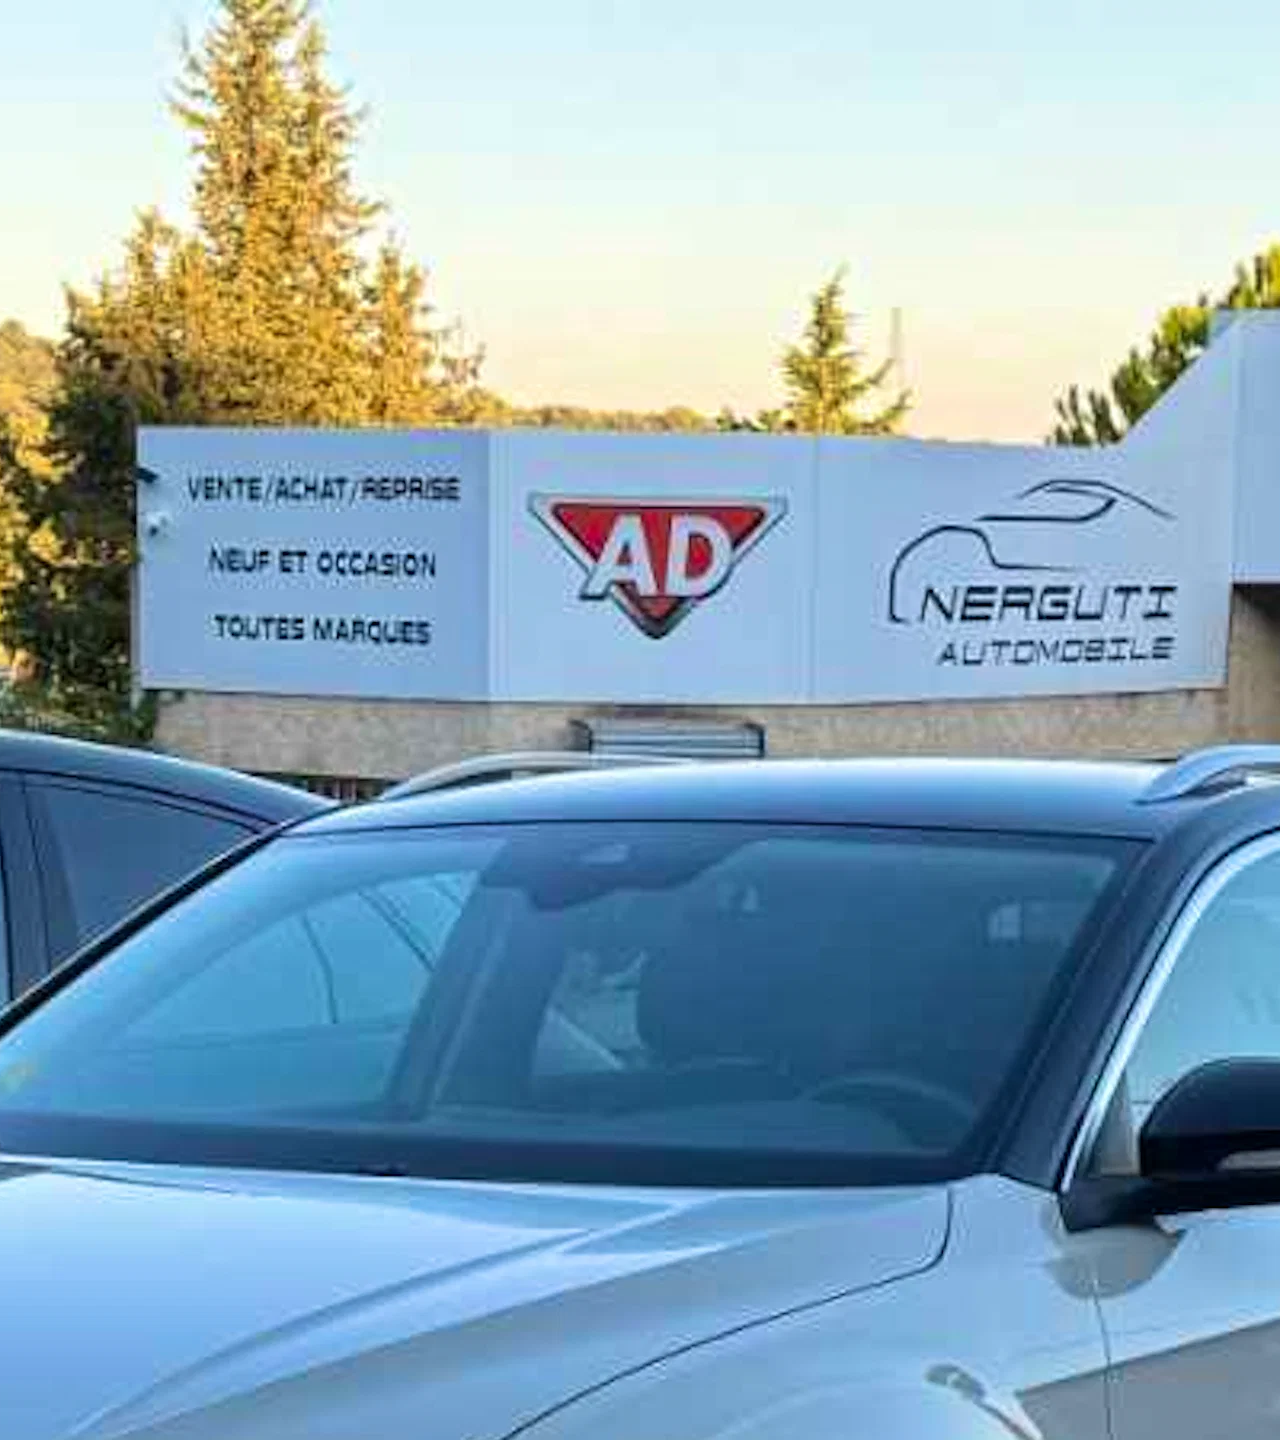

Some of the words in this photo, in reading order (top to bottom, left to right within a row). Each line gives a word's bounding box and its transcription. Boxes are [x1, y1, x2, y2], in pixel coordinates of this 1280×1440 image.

[187, 476, 461, 504] VENTE/ACHAT/REPRISE
[209, 545, 271, 574] NEUF
[279, 549, 308, 573] ET
[317, 551, 436, 577] OCCASION
[579, 511, 736, 600] AD
[919, 584, 1177, 622] NERGUTI
[214, 614, 305, 640] TOUTES
[313, 617, 433, 645] MARQUES
[936, 636, 1175, 666] AUTOMOBILE
